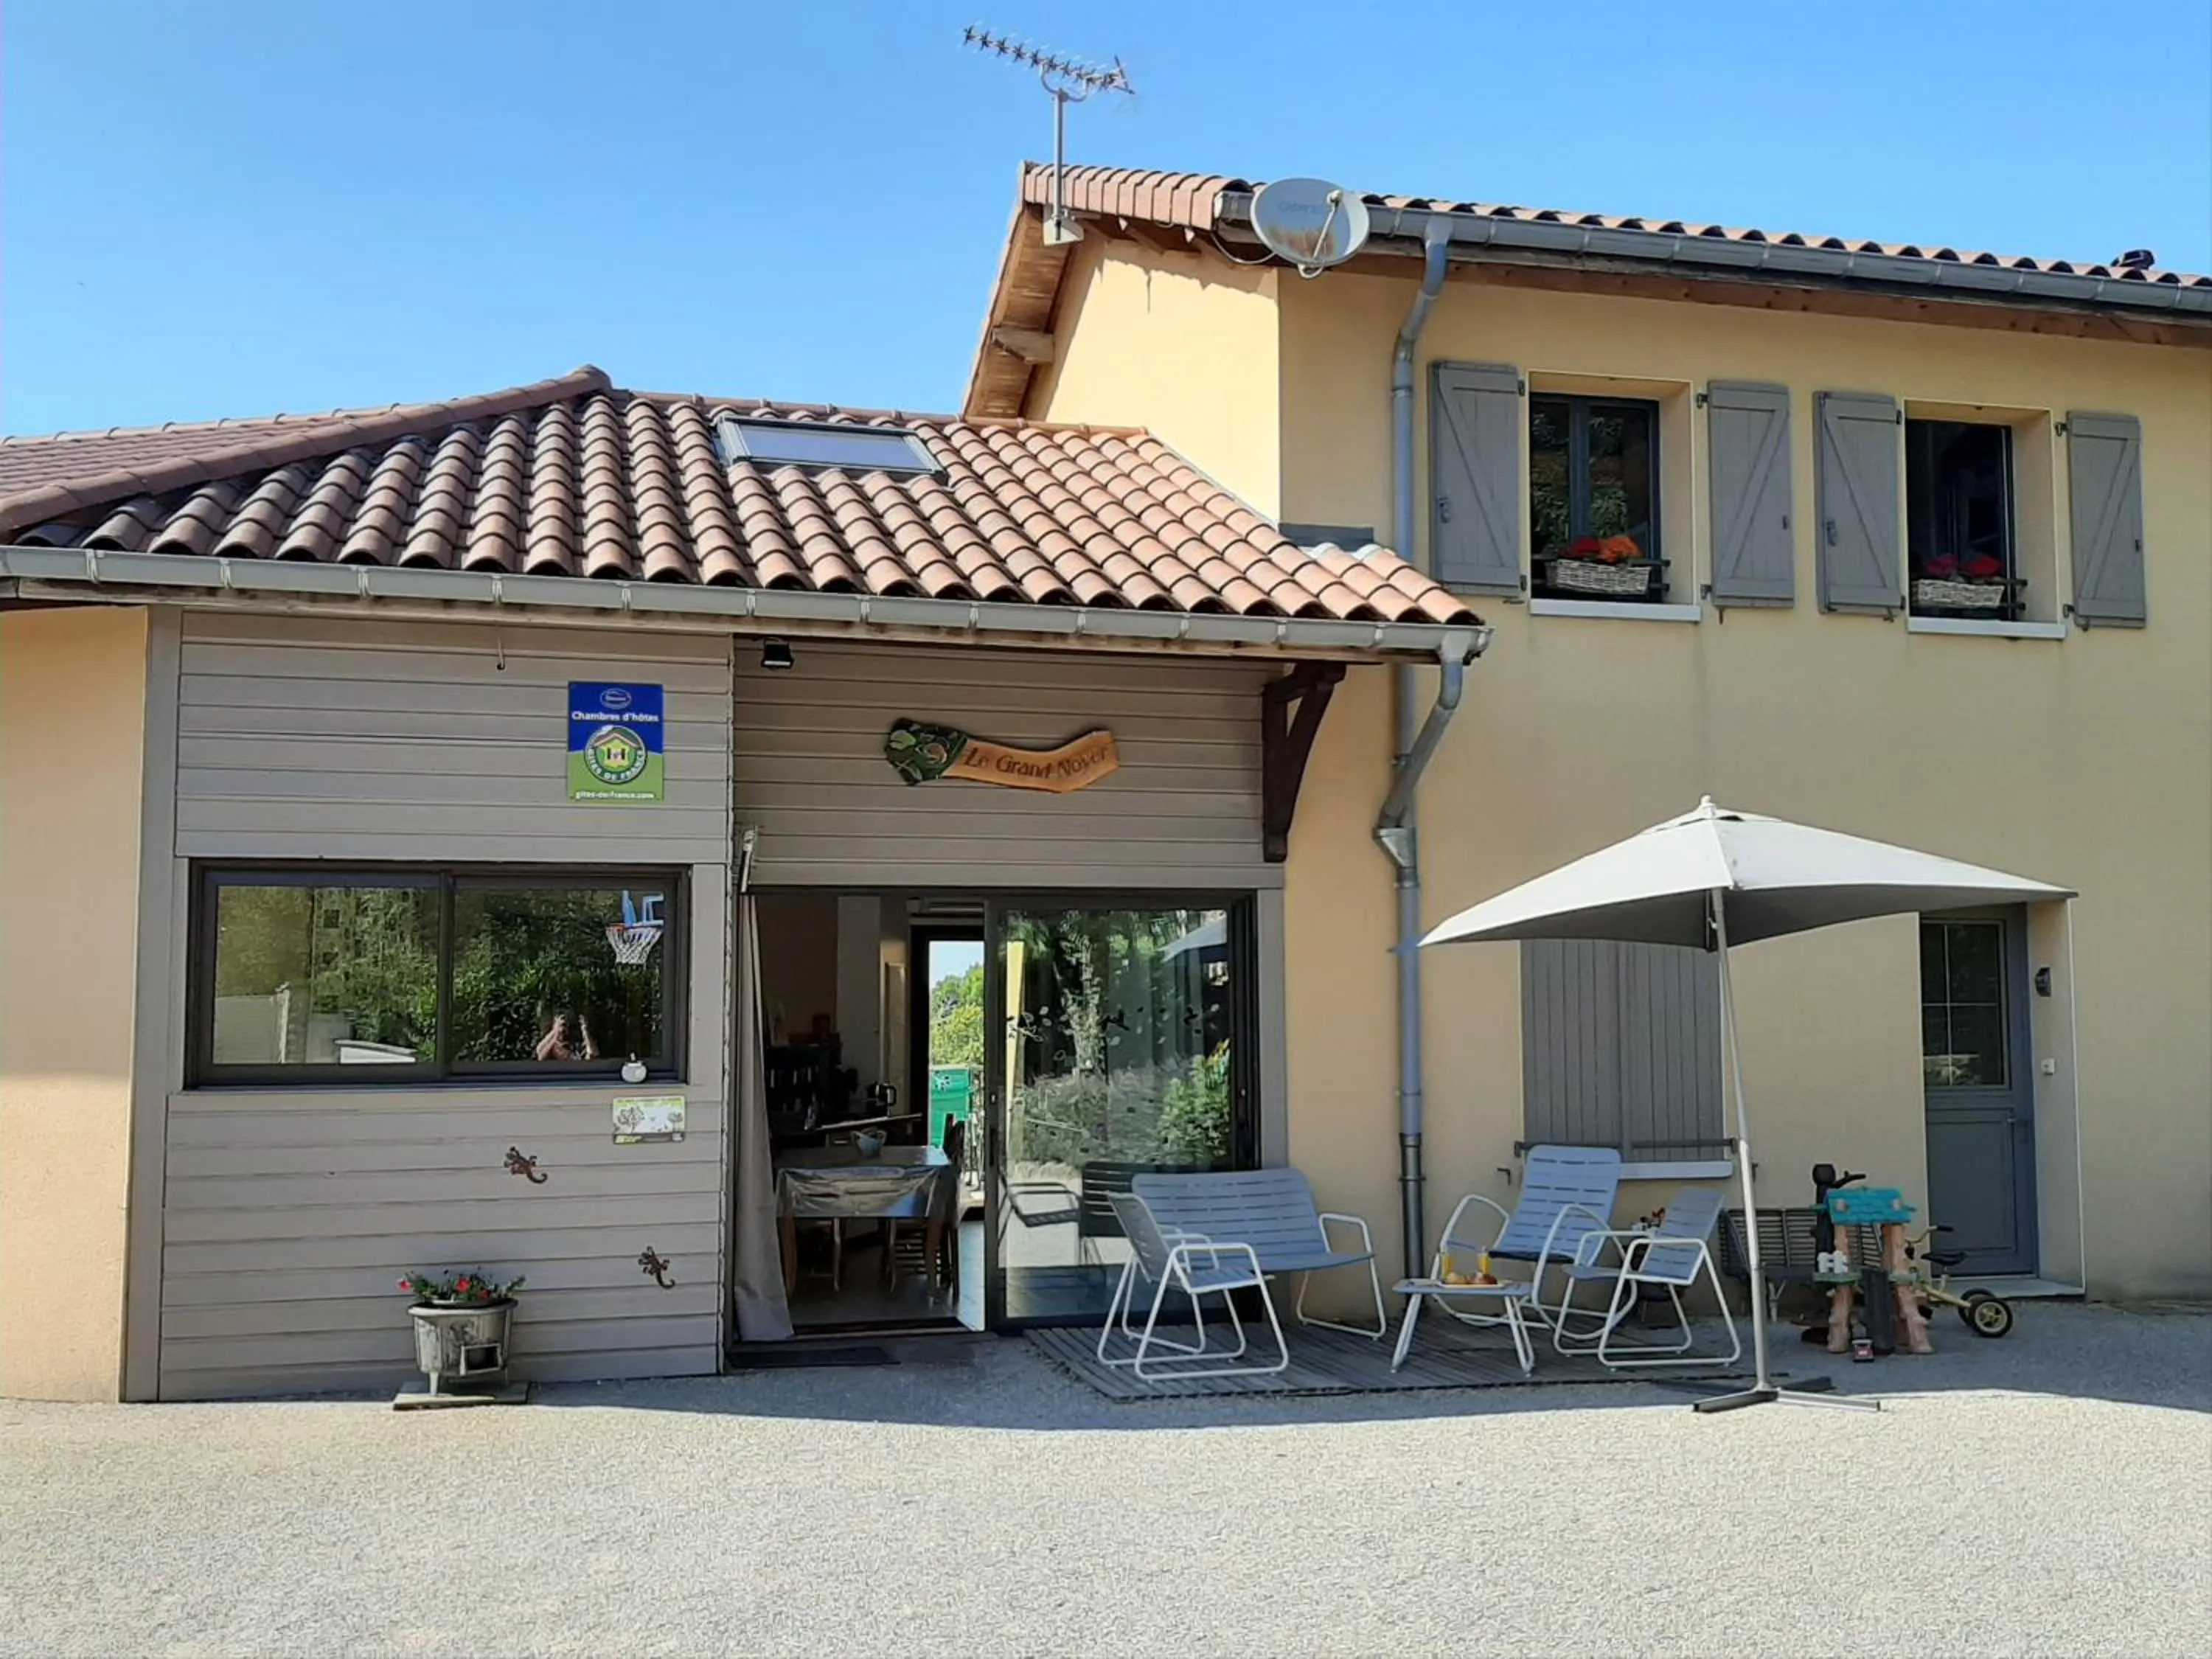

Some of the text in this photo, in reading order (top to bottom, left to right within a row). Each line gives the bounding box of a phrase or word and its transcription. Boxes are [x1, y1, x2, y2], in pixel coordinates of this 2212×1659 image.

[571, 711, 620, 721] Chambres
[963, 747, 990, 768] Le
[995, 754, 1051, 779] Grand
